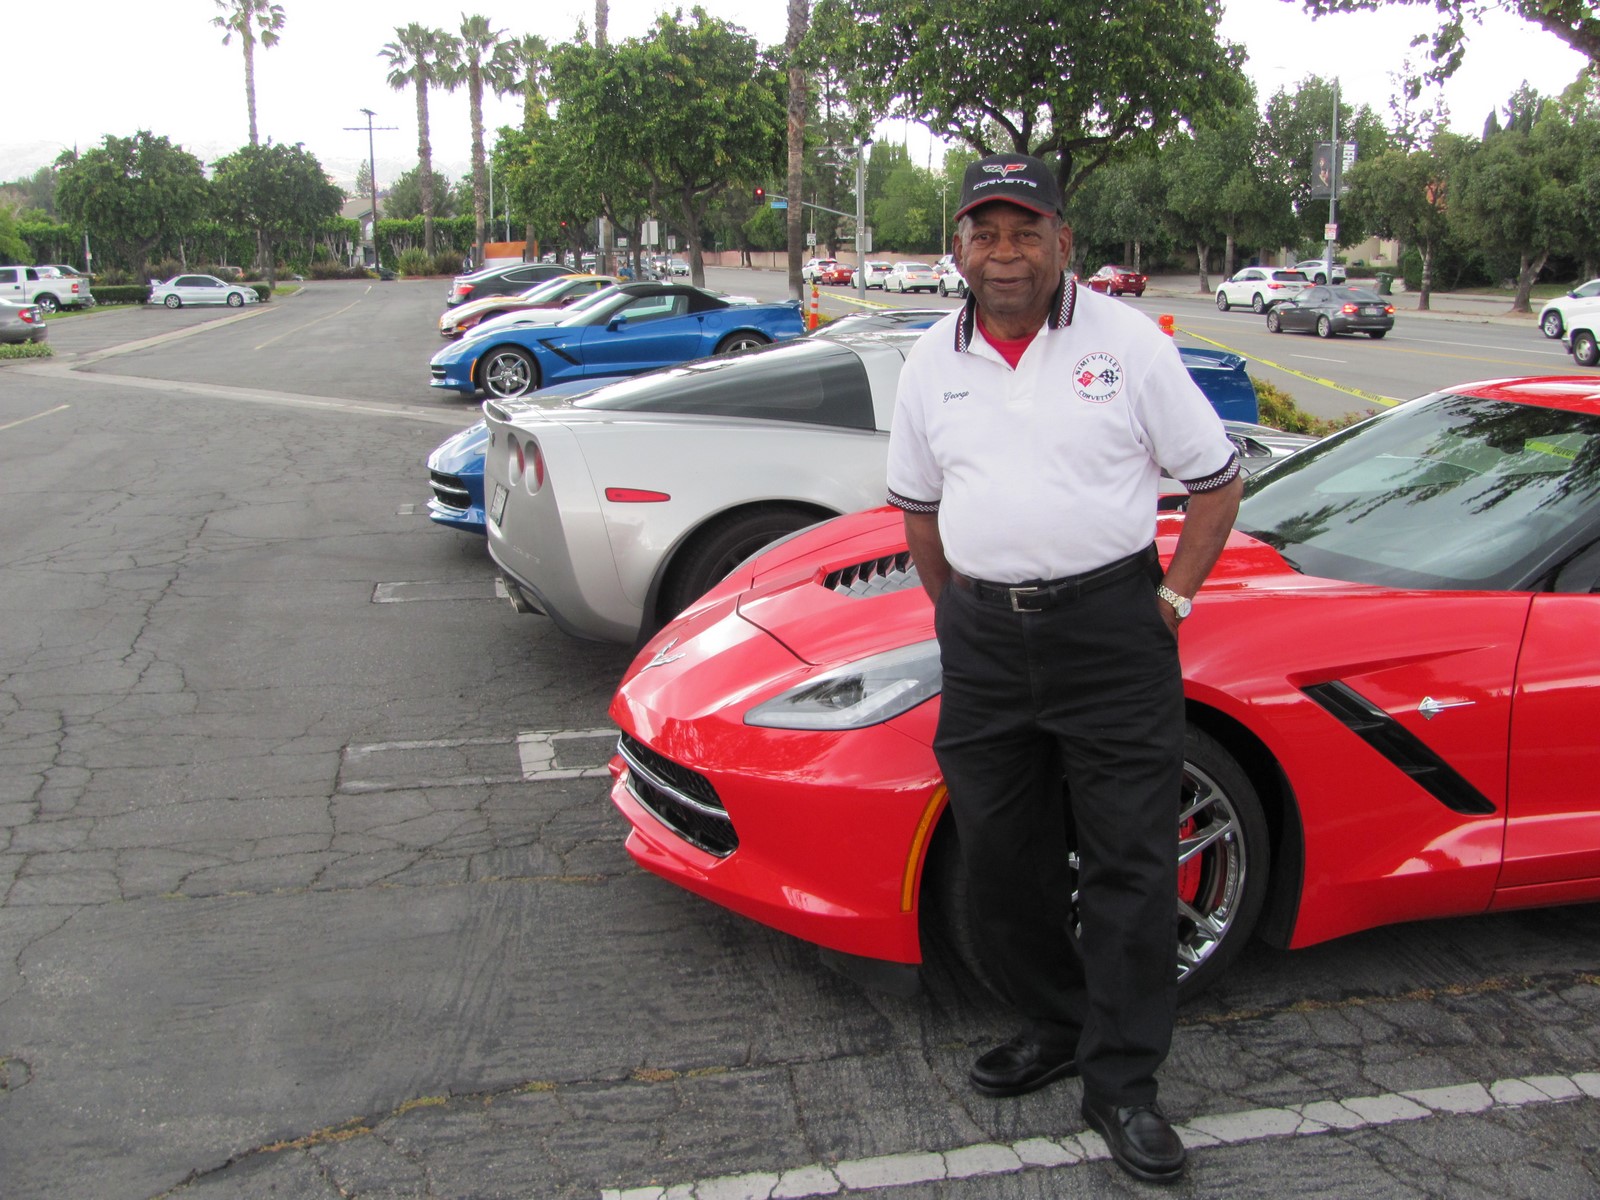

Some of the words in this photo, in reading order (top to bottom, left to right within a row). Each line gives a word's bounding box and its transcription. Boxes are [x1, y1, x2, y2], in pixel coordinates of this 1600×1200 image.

[973, 178, 1038, 191] CORVETTE
[1075, 358, 1090, 375] SIMI
[1091, 354, 1121, 373] VALLEY
[943, 391, 969, 403] George
[1078, 389, 1116, 401] CORVETTES
